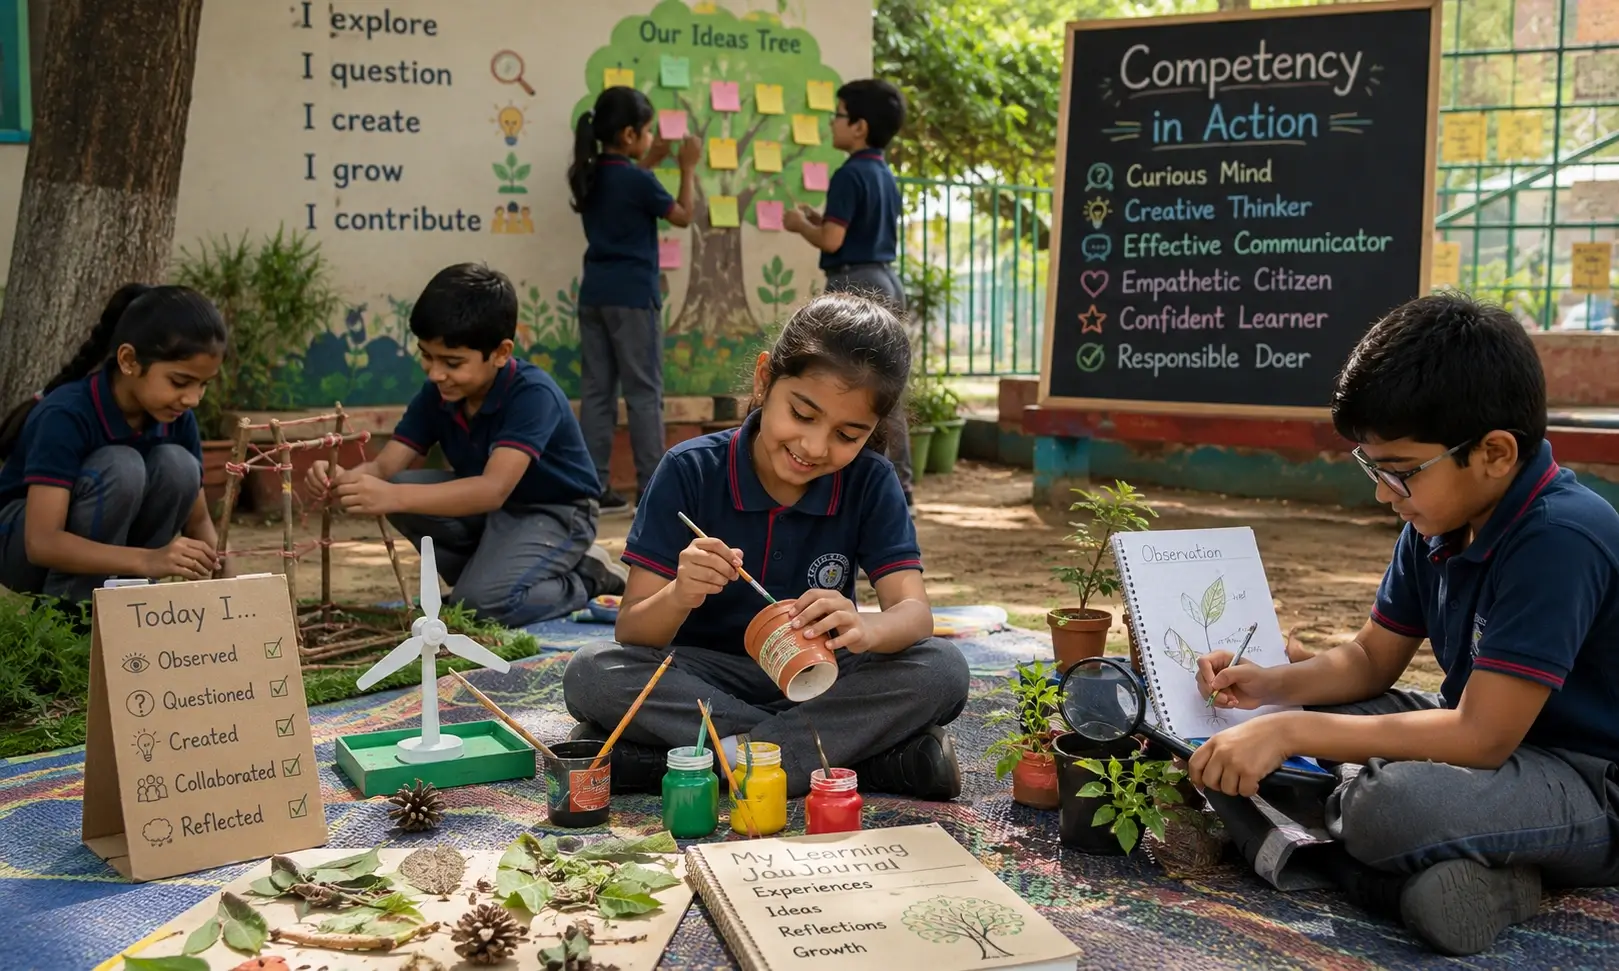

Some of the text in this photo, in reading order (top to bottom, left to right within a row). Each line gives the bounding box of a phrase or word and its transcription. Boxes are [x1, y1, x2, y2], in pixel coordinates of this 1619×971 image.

[301, 2, 438, 40] I explore
[639, 21, 802, 55] Our Ideas Tree
[302, 52, 452, 89] I question
[1120, 39, 1363, 99] Competency
[303, 103, 421, 133] I create
[1152, 102, 1318, 143] in Action
[304, 153, 404, 189] I grow
[1126, 159, 1273, 188] Curious Mind
[305, 203, 482, 233] I contribute
[1124, 194, 1313, 223] Creative Thinker
[1123, 228, 1394, 259] Effective Communicator
[1122, 267, 1333, 301] Empathetic Citizen
[1119, 304, 1330, 333] Confident Learner
[1117, 341, 1312, 377] Responsible Doer
[1141, 543, 1223, 562] Observation
[126, 600, 205, 632] Today
[157, 644, 239, 670] Observed
[162, 682, 255, 710] Questioned
[168, 724, 239, 751] Created
[174, 760, 277, 793] Collaborated
[180, 804, 264, 837] Reflected
[731, 843, 909, 868] My Learning
[752, 878, 873, 899] Experiences
[765, 903, 823, 918] Ideas
[778, 919, 887, 939] Reflections
[792, 941, 868, 959] Growth
